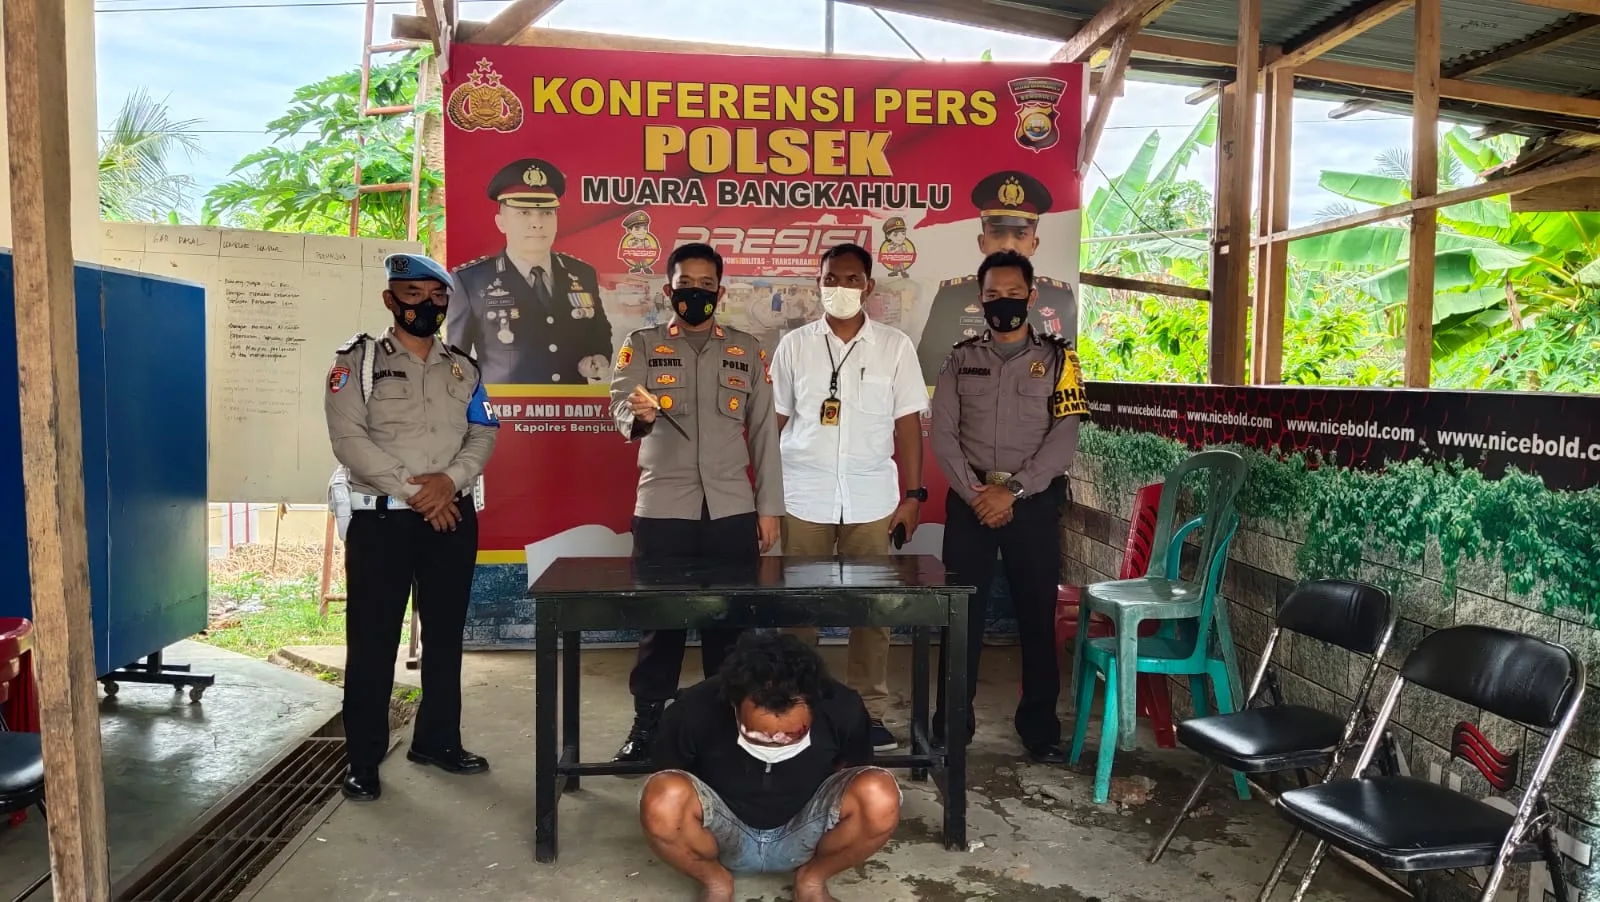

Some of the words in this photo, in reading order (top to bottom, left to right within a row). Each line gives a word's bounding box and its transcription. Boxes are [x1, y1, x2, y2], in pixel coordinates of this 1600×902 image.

[532, 76, 855, 123] KONFERENSI
[875, 88, 998, 126] PERS
[643, 125, 893, 177] POLSEK
[581, 176, 708, 206] MUARA
[717, 179, 952, 210] BANGKAHULU
[672, 226, 868, 255] PRESISI
[723, 256, 765, 265] PONSIBILITAS
[722, 359, 749, 373] POLRI
[493, 404, 521, 418] KBP
[525, 404, 560, 418] ANDI
[514, 423, 566, 434] Kapolres
[1117, 403, 1178, 419] www.nicebold.com
[1187, 409, 1273, 429] www.nicebold.com
[1286, 417, 1415, 442] www.nicebold.com
[1437, 428, 1600, 462] www.nicebold.c
